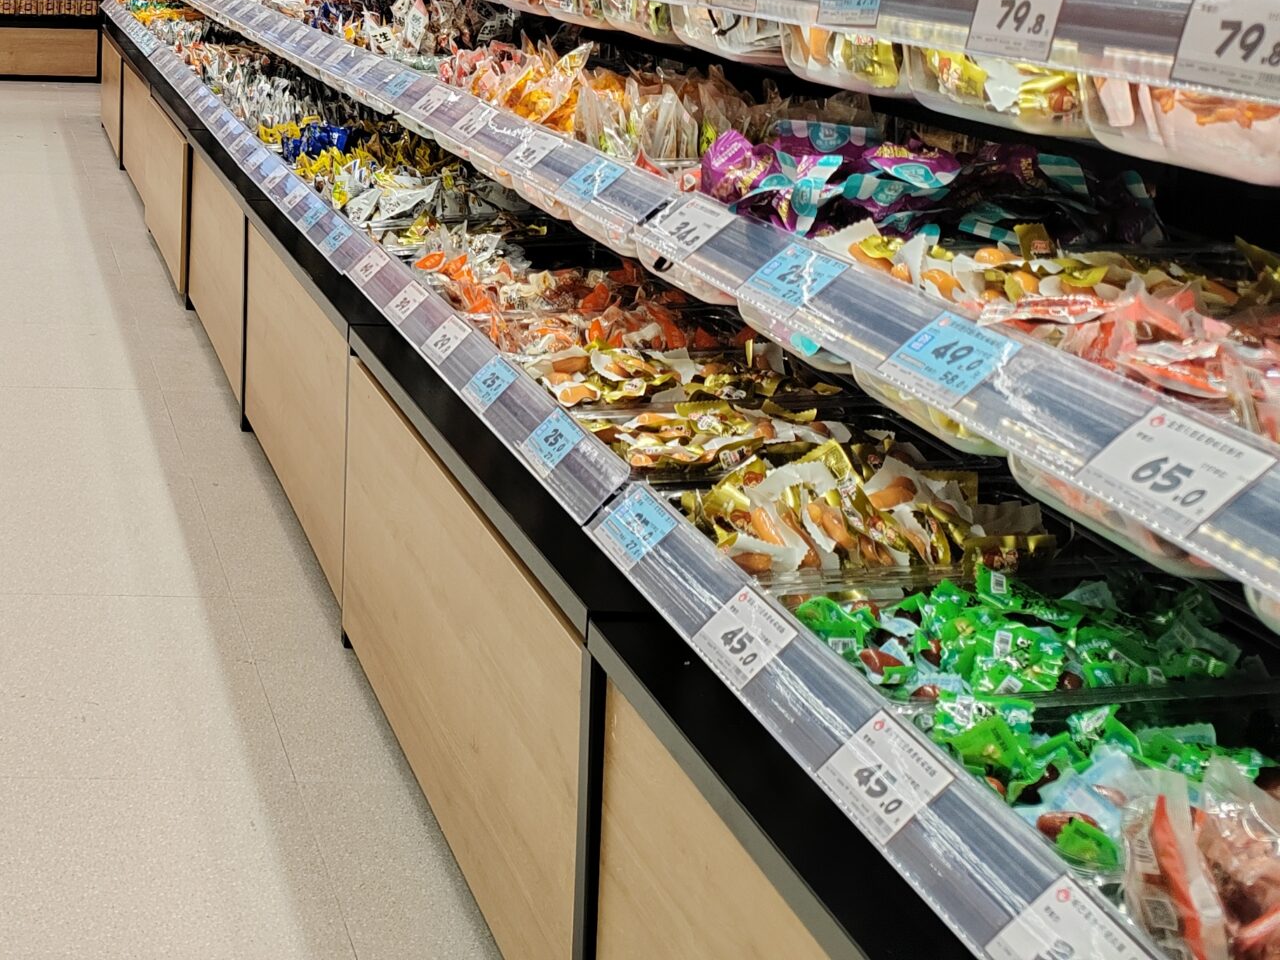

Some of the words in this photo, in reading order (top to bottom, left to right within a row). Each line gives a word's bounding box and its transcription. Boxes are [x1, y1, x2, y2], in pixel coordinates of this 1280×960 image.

[931, 339, 984, 372] 49.0
[543, 428, 564, 453] 25.0
[1131, 456, 1208, 508] 65.0
[720, 625, 759, 667] 45.0
[853, 763, 904, 815] 45.0
